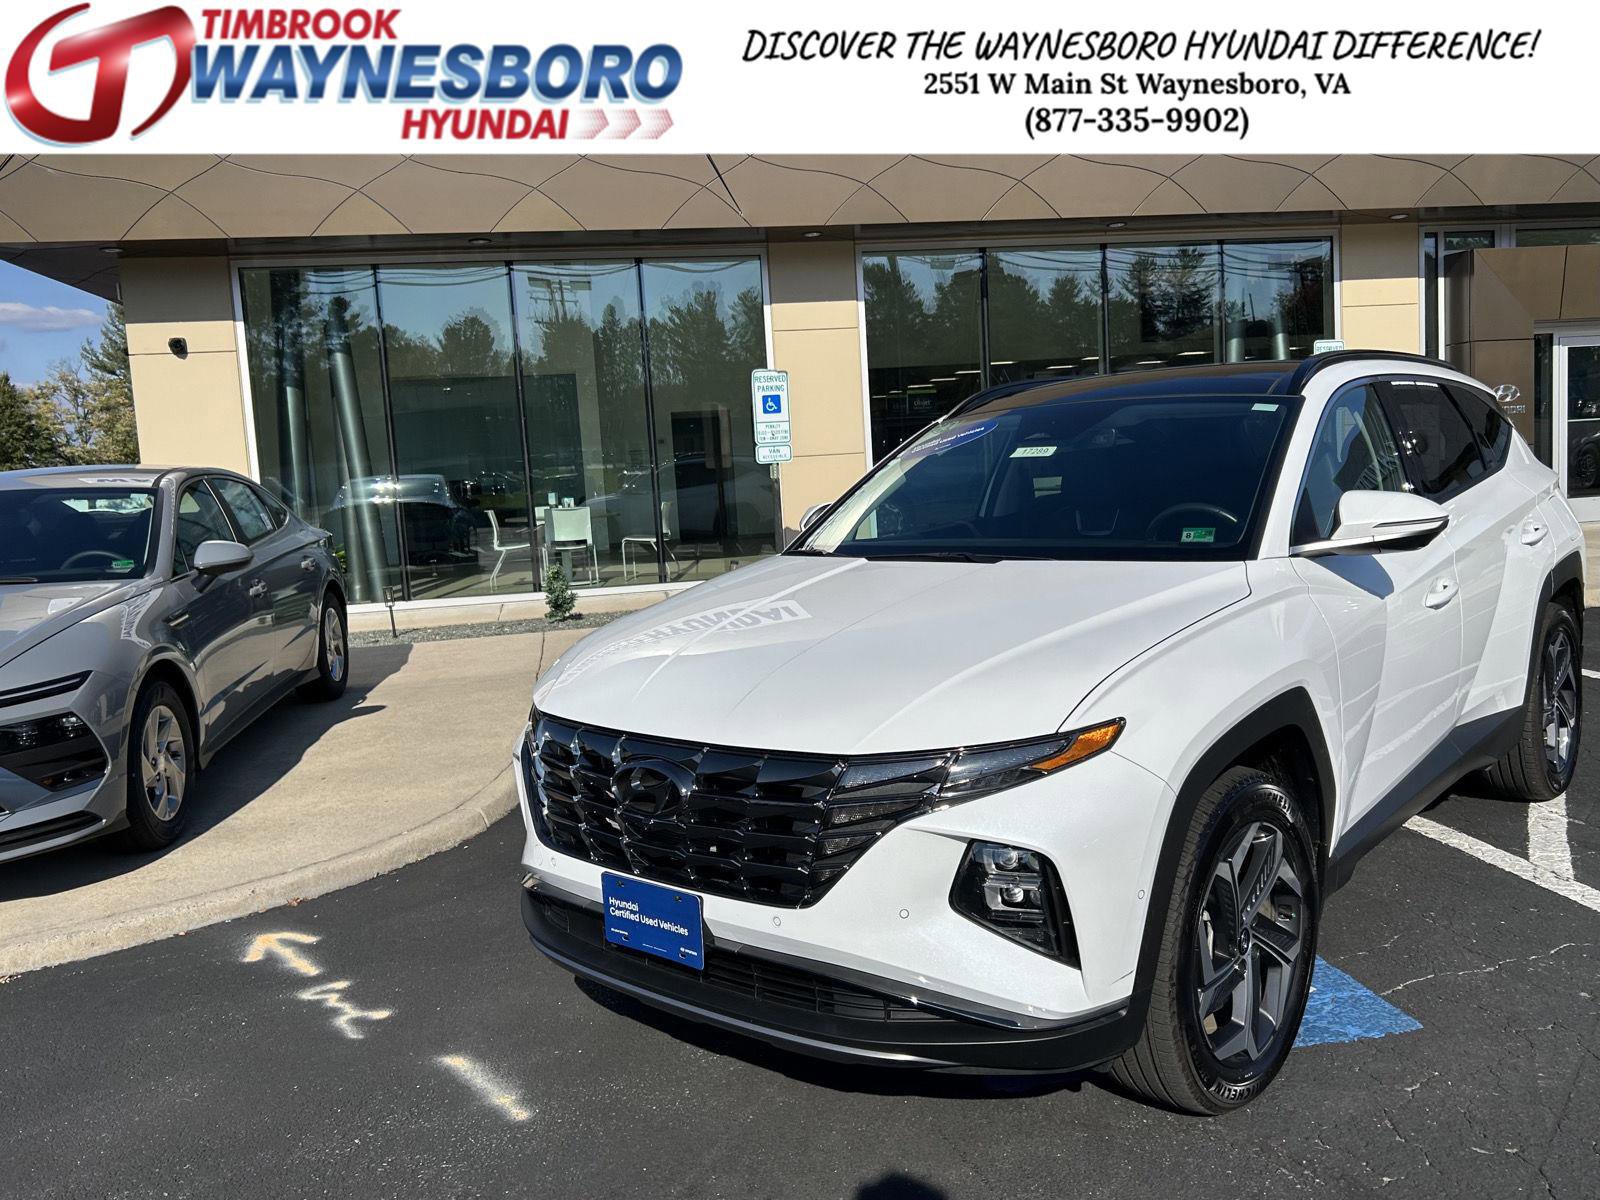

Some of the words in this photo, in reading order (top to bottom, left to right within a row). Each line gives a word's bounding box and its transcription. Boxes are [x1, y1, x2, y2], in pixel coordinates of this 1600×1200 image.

[753, 374, 787, 384] RESERVED
[757, 384, 785, 393] PARKING
[608, 896, 639, 911] Hyundai
[609, 906, 640, 922] Certified
[640, 915, 658, 928] Used
[658, 919, 689, 936] Vehicles
